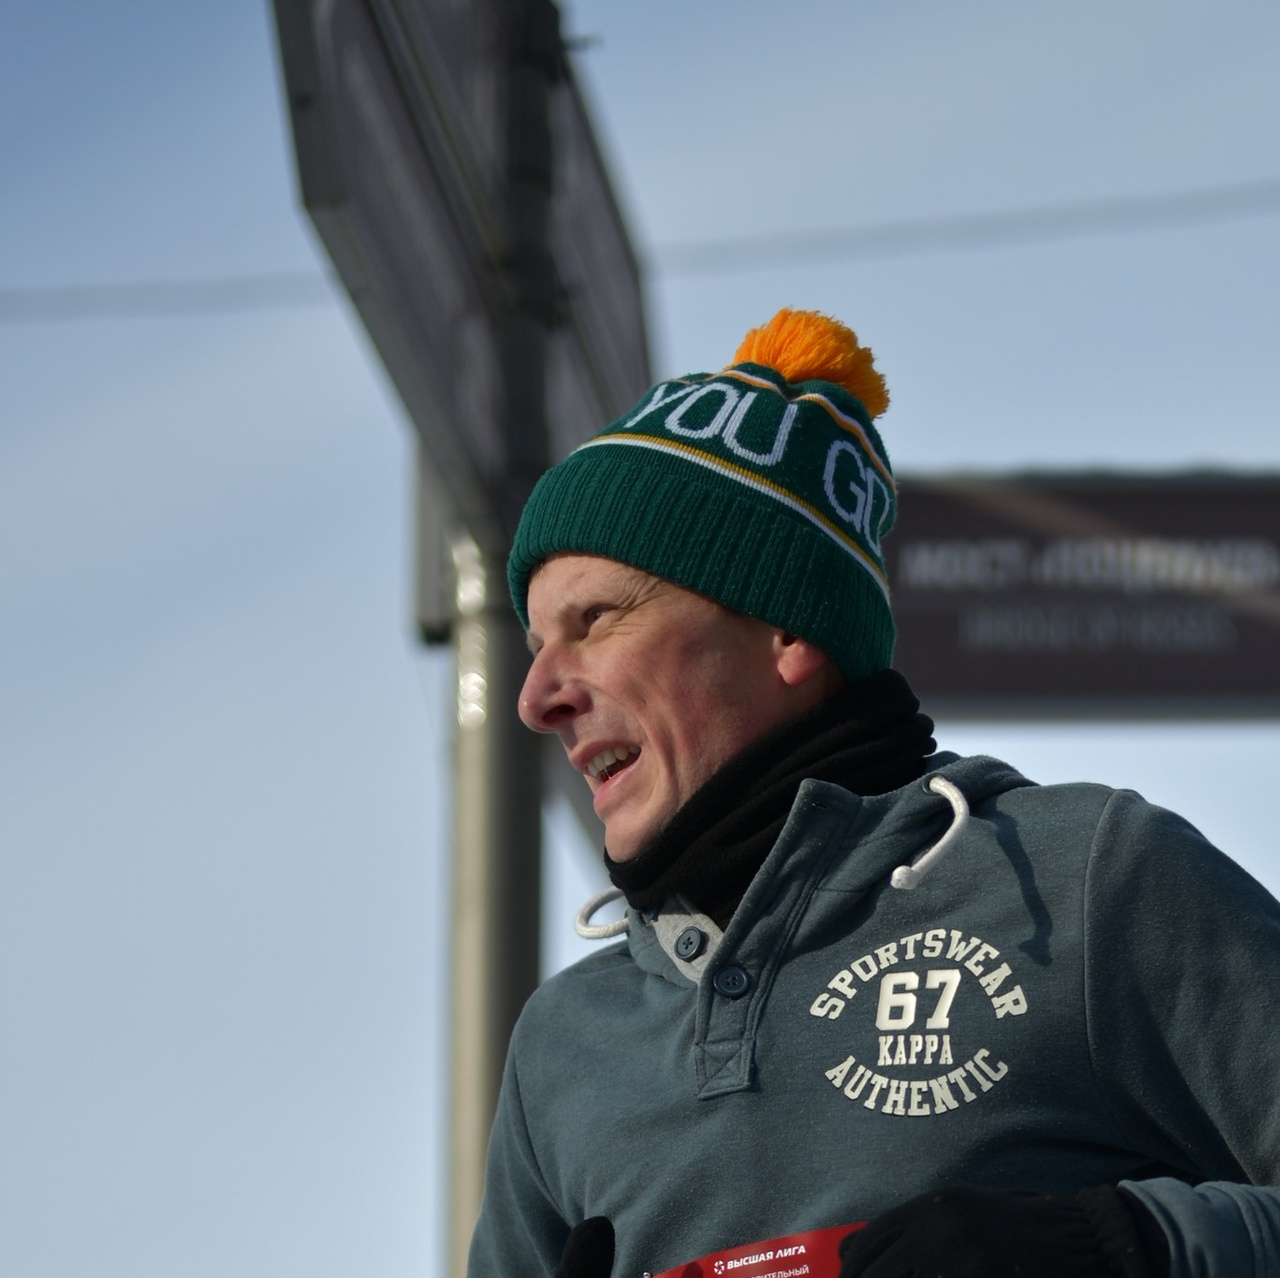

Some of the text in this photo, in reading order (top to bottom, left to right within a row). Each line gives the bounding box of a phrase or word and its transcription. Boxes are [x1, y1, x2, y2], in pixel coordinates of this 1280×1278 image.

[624, 382, 798, 466] YOU
[809, 928, 1028, 1020] SPORTSWEAR
[875, 969, 962, 1031] 67
[824, 1048, 1009, 1116] AUTHENTIC
[877, 1034, 953, 1066] KAPPA
[727, 1245, 806, 1270] ВЫСШАЯ ЛИГА
